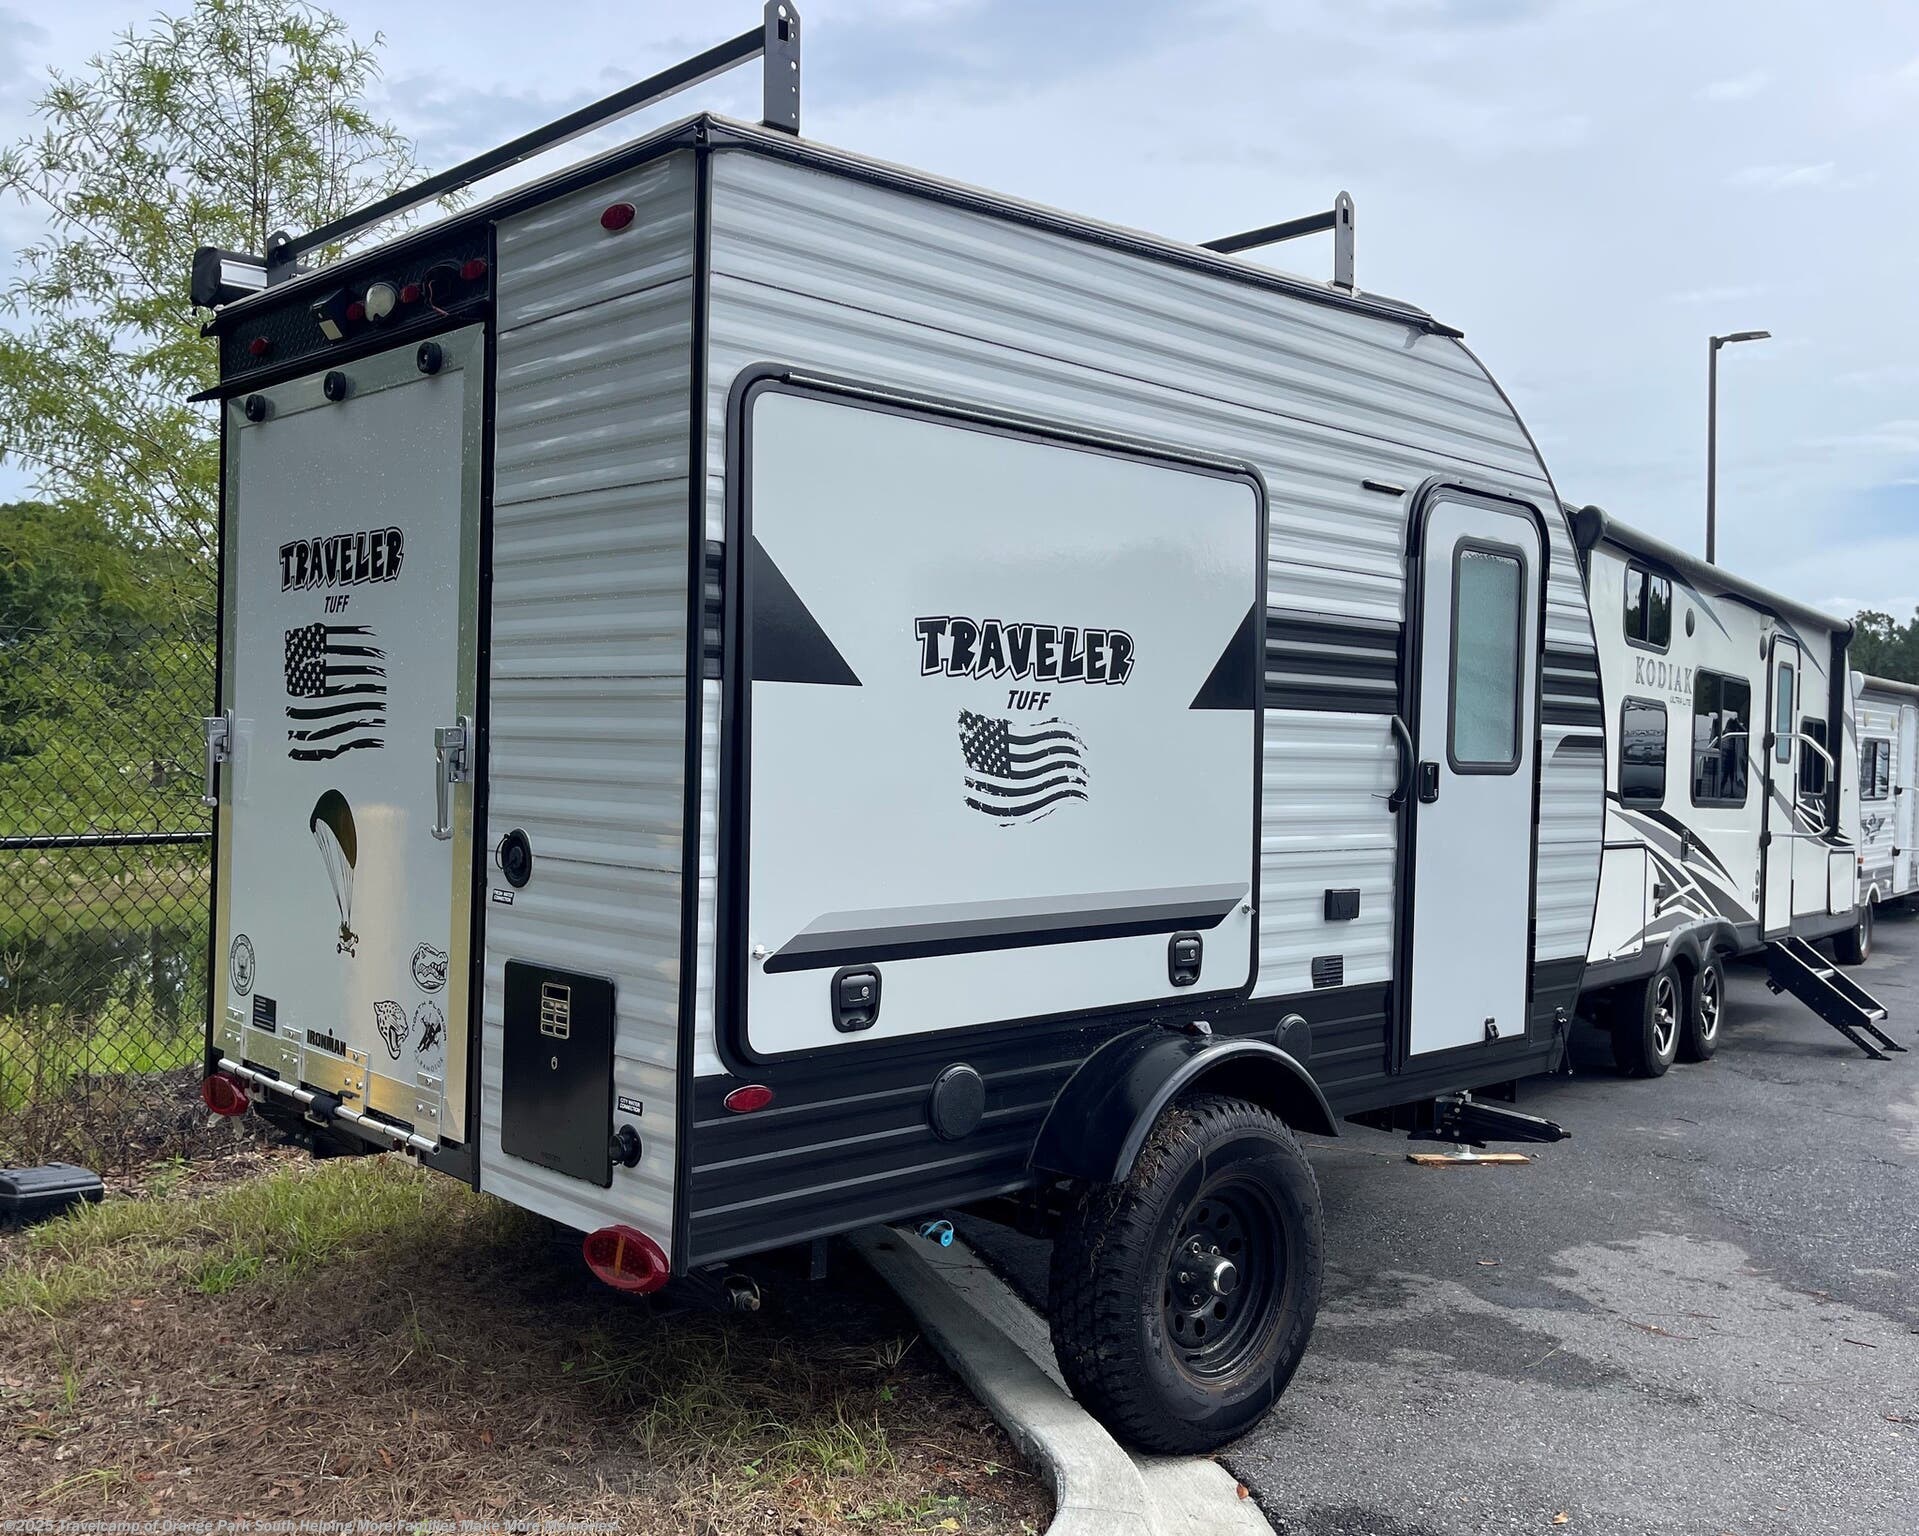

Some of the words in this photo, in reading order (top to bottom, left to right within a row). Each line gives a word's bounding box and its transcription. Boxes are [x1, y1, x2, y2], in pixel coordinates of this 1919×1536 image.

[279, 526, 405, 592] TRAVELER
[324, 594, 350, 614] TUFF
[914, 615, 1136, 686] TRAVELER
[1635, 655, 1693, 694] KODIAK
[1007, 689, 1052, 711] TUFF
[306, 1028, 347, 1058] IRONMAN
